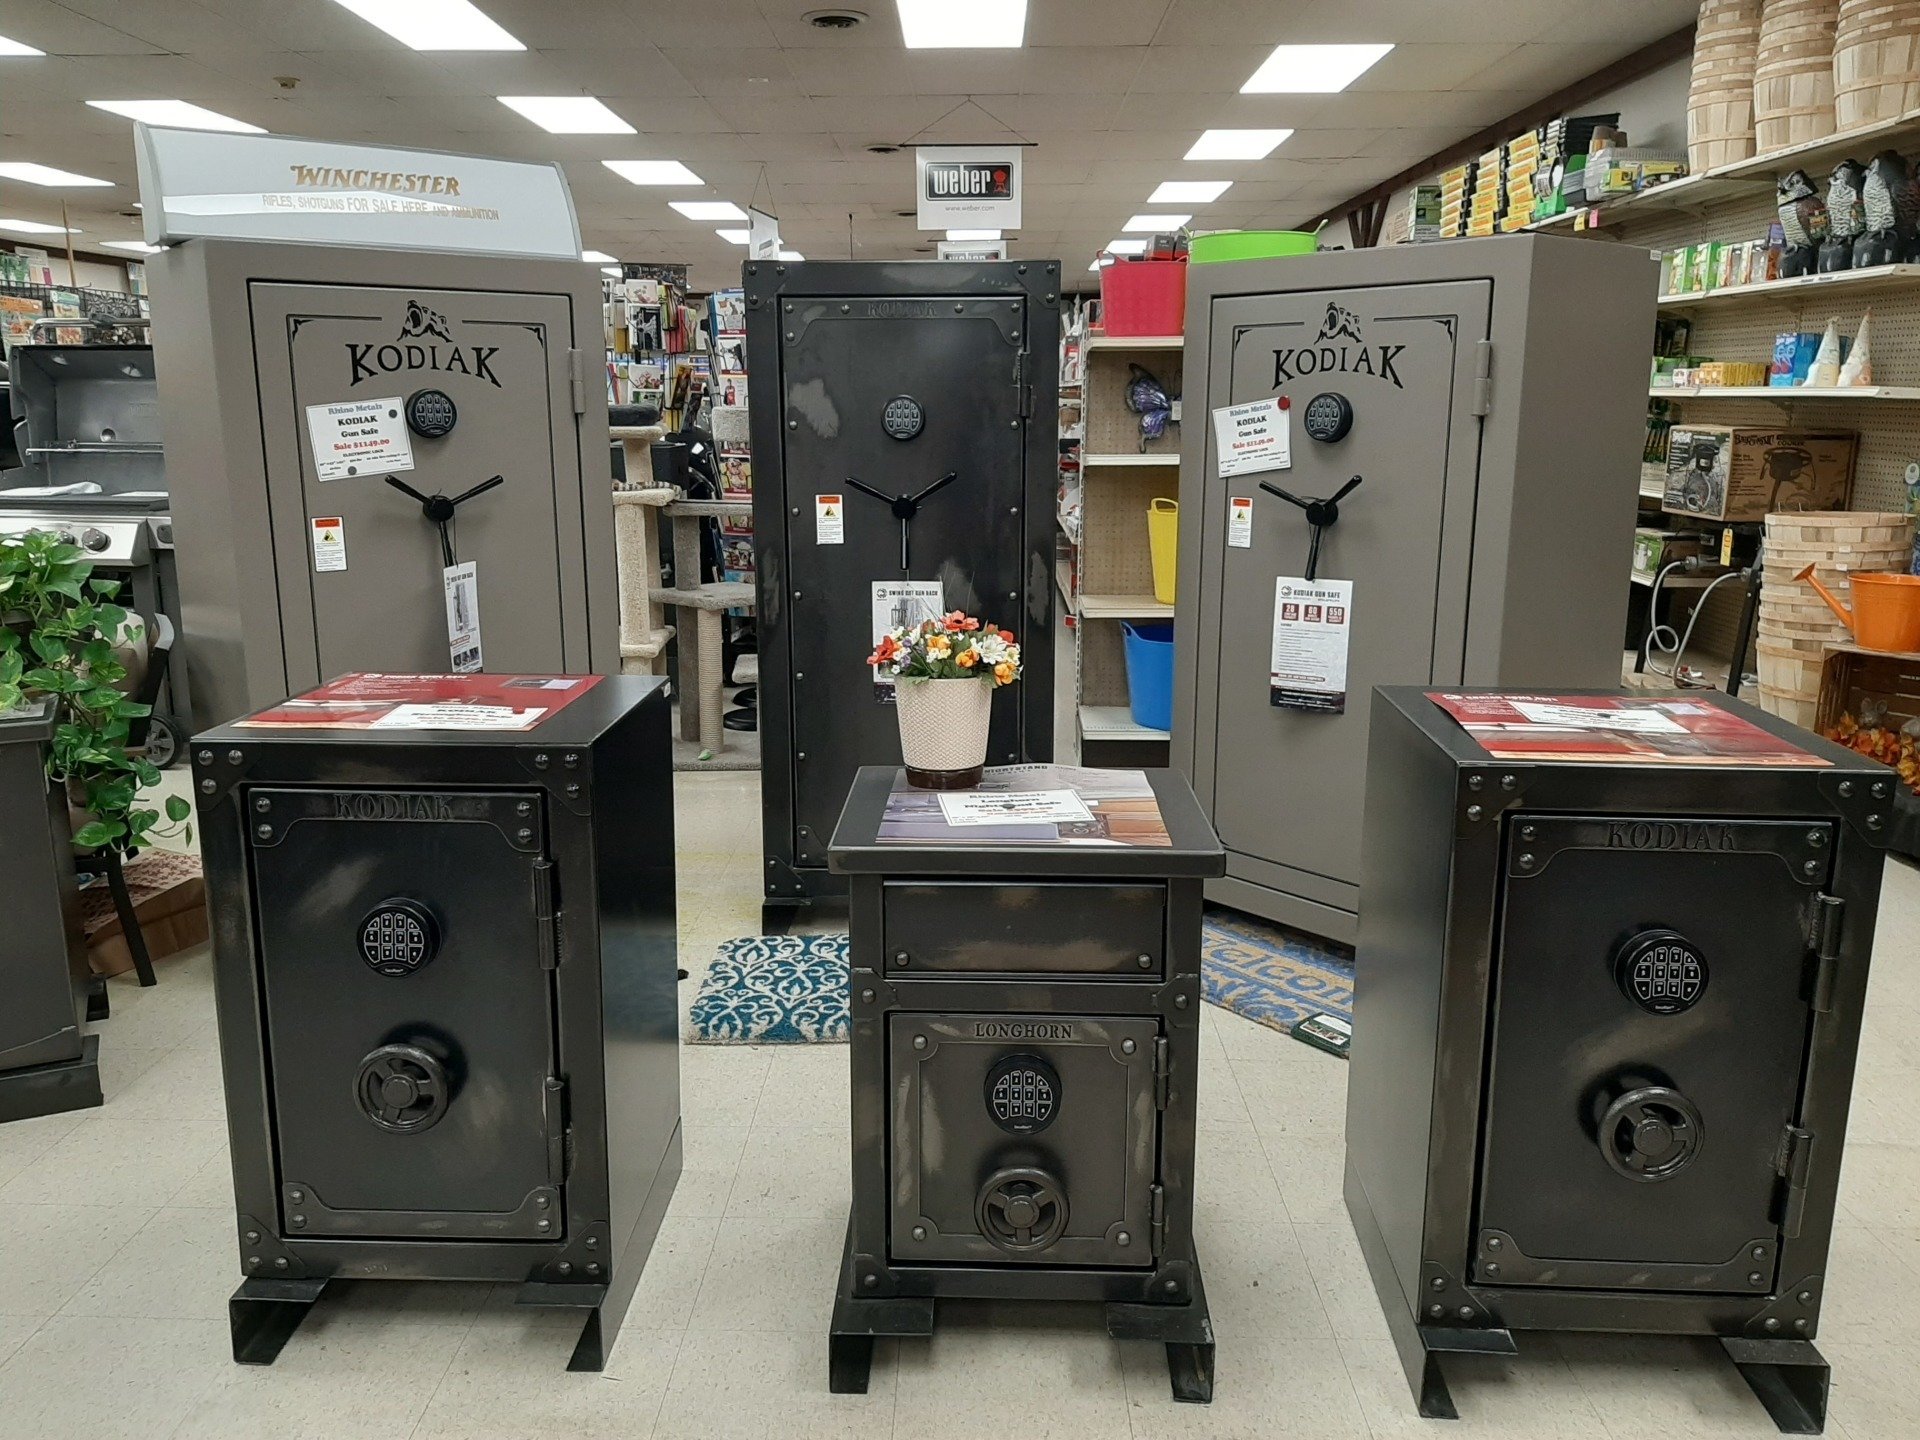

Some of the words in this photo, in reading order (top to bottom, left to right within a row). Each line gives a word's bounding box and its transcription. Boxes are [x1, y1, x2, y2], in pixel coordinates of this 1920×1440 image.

[290, 164, 461, 197] WINCHESTER
[932, 164, 991, 195] weber
[262, 194, 297, 210] RIFLES,
[298, 196, 345, 211] SHOTGUNS
[346, 197, 369, 212] FOR
[373, 198, 398, 213] SALE
[401, 201, 428, 215] HERE
[432, 205, 451, 217] AND
[945, 204, 995, 212] www.weber.com
[345, 343, 502, 388] KODIAK
[1271, 345, 1406, 390] KODIAK
[328, 405, 354, 415] Rhino
[356, 403, 383, 413] Metals
[1229, 409, 1249, 417] Rhino
[1250, 404, 1272, 412] Metals
[337, 415, 378, 426] KODIAK
[1236, 415, 1267, 427] KODIAK
[341, 430, 359, 438] Gun
[361, 428, 379, 436] Safe
[333, 443, 352, 451] Sale
[1286, 604, 1295, 612] 28
[333, 793, 453, 820] KODIAK
[1605, 821, 1736, 850] KODIAK
[975, 1023, 1073, 1039] LONGHORN
